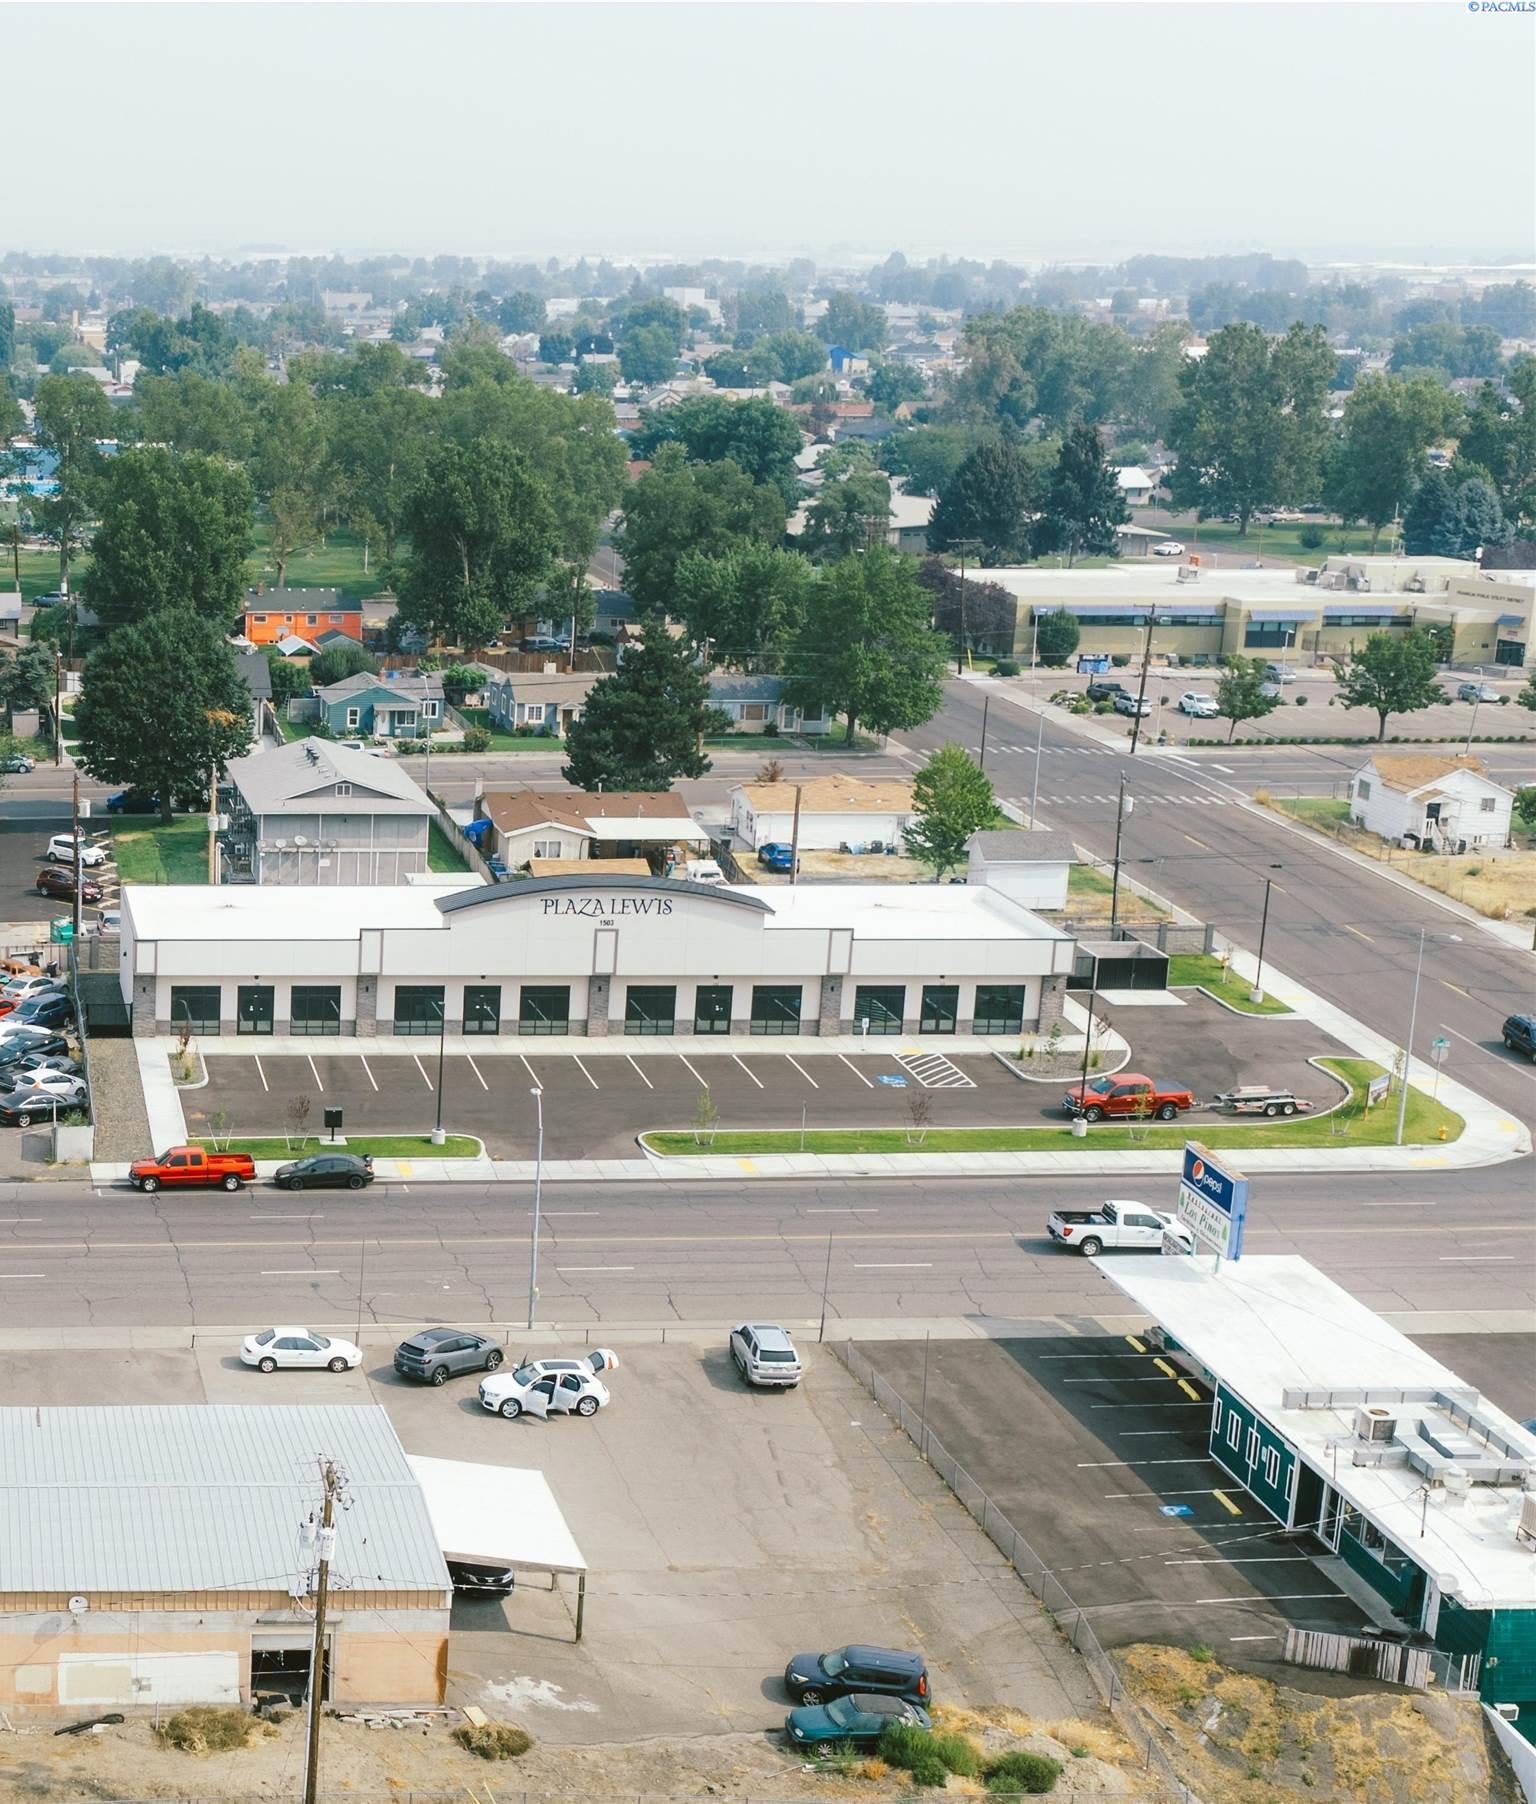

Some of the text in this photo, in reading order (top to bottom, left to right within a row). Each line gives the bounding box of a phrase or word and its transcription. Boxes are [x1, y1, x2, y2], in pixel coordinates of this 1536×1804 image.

[540, 897, 672, 917] PLAZA LEWIS
[1203, 1174, 1223, 1194] pepsi
